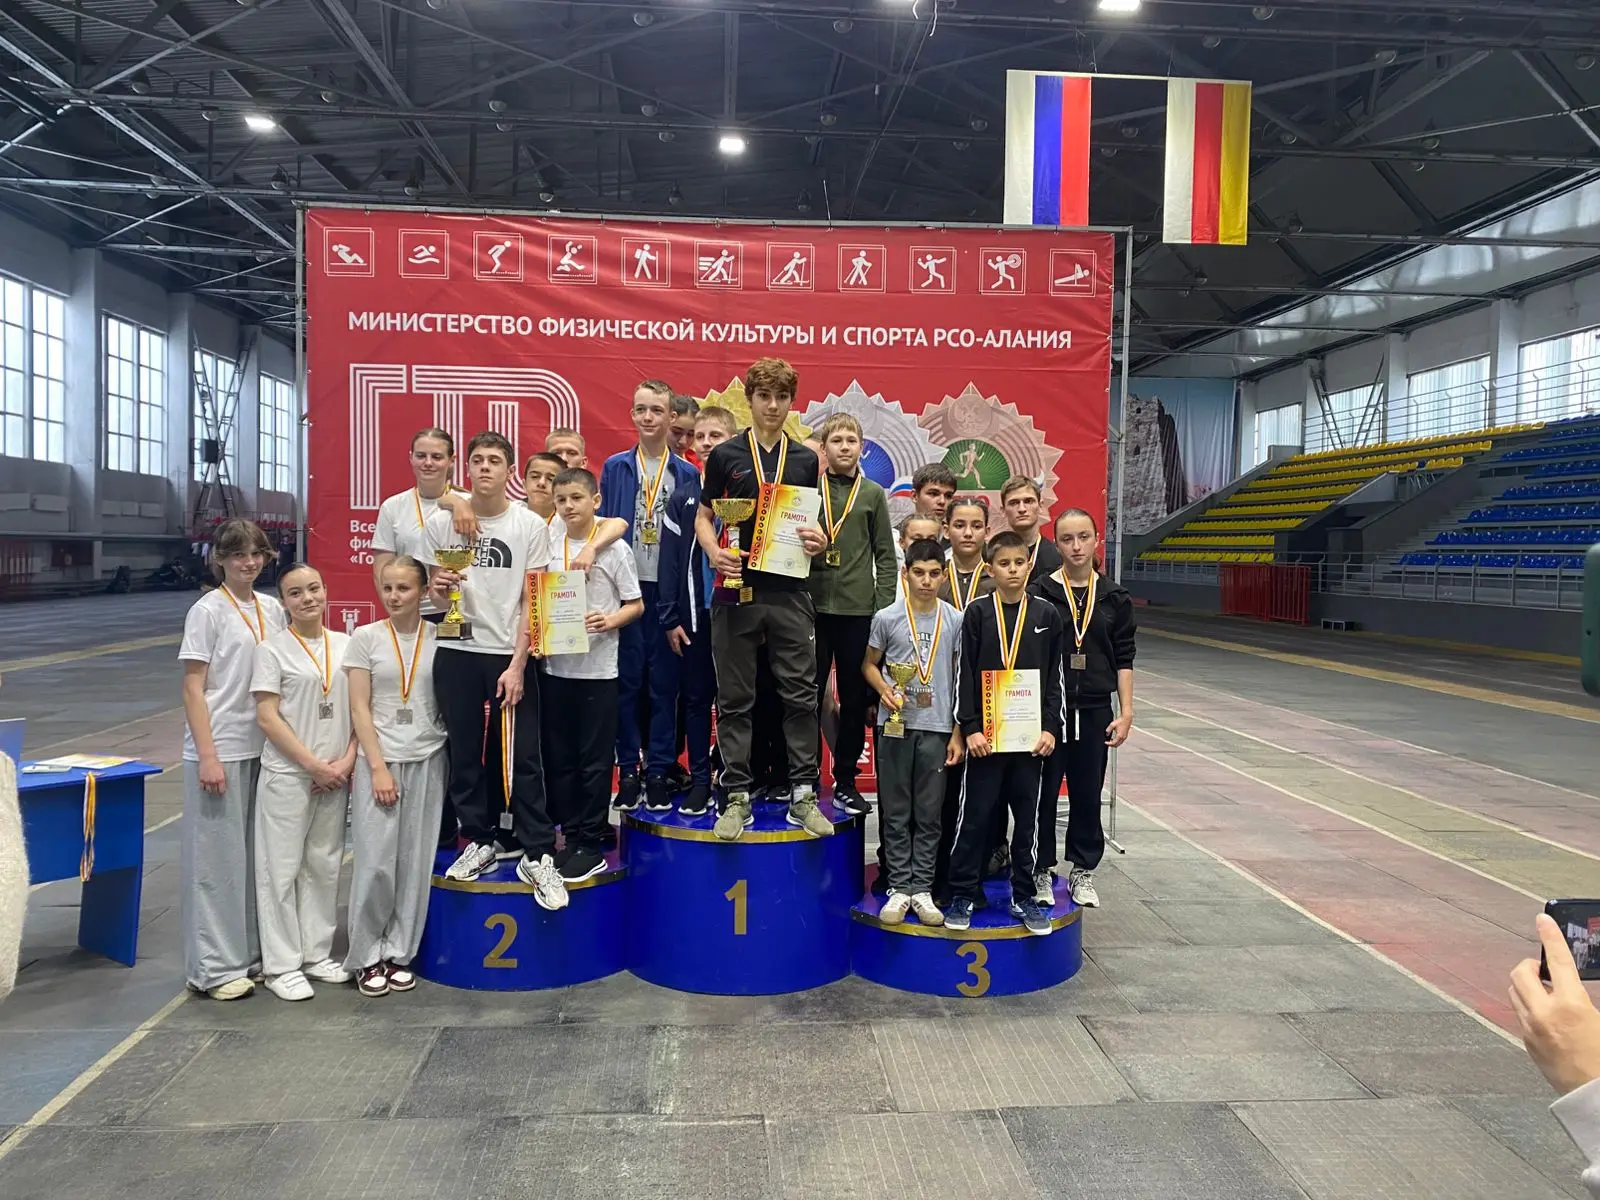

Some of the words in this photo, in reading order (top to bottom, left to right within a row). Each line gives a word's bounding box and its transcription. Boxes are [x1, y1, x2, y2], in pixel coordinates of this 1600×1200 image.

[348, 311, 533, 336] МИНИСТЕРСТВО
[538, 316, 695, 341] ФИЗИЧЕСКОЙ
[701, 322, 815, 345] КУЛЬТУРЫ
[821, 325, 837, 345] И
[843, 326, 928, 347] СПОРТА
[933, 328, 1072, 349] РСО-АЛАНИЯ
[780, 511, 807, 523] ГРАМОТА
[350, 519, 377, 533] Все
[349, 536, 372, 551] фи
[350, 551, 375, 564] «Го
[550, 591, 577, 600] ГРАМОТА
[1005, 689, 1032, 697] ГРАМОТА
[724, 879, 747, 935] 1
[483, 913, 517, 968] 2
[955, 941, 990, 997] 3
